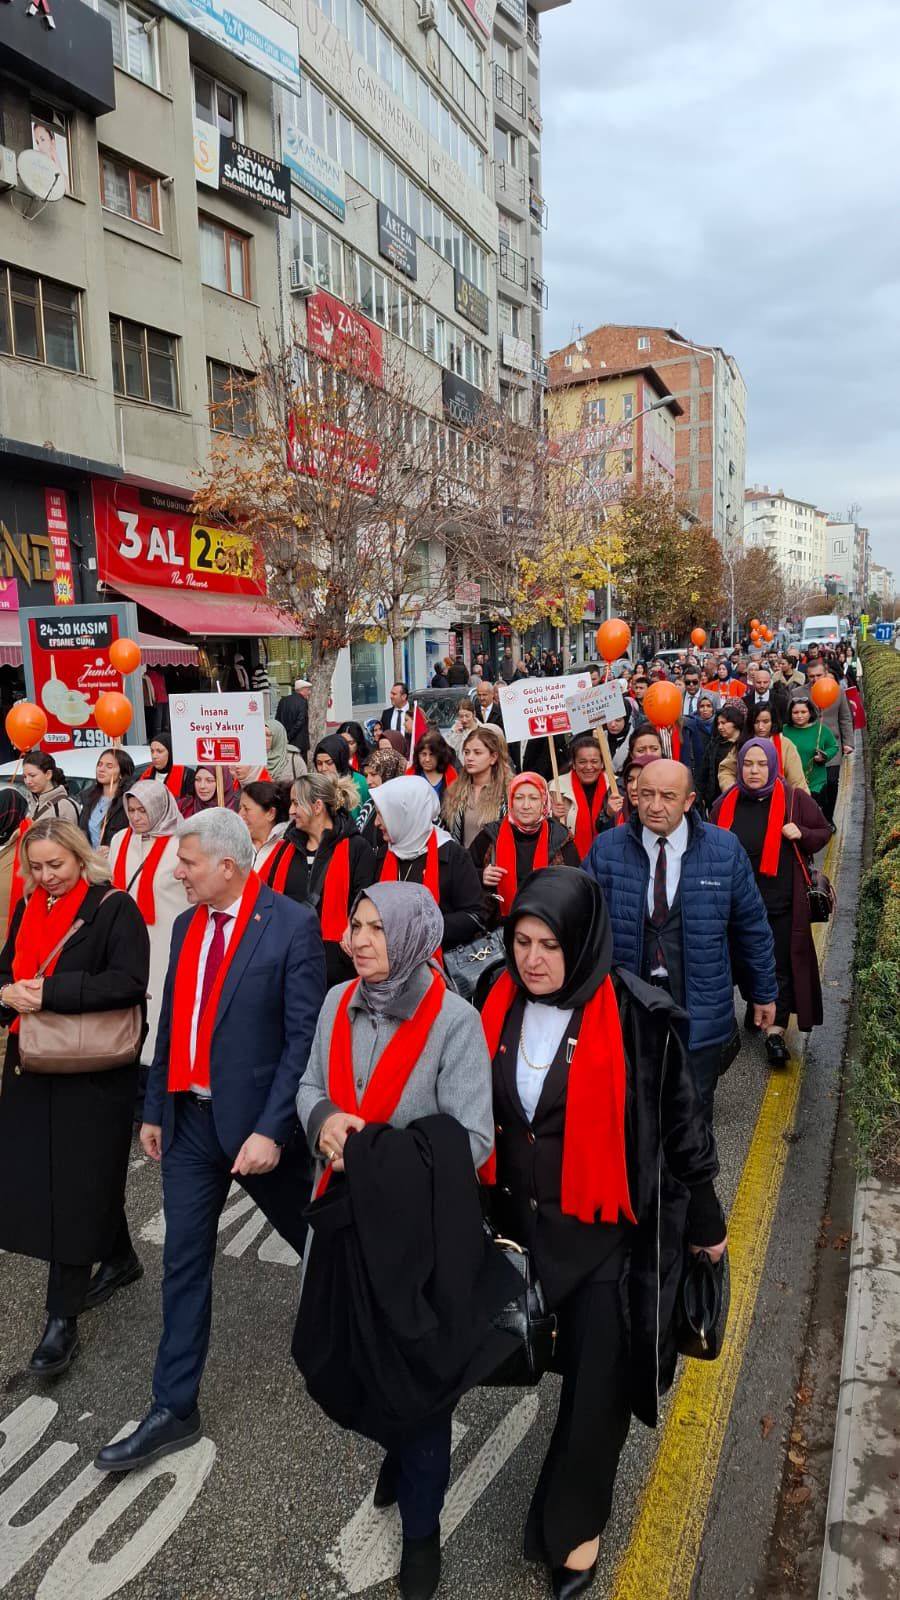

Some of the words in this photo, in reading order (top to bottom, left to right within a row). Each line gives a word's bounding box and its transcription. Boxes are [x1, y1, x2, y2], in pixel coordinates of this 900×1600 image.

[306, 2, 354, 73] UZAY
[298, 136, 340, 184] KARAMAN
[224, 164, 286, 204] SARIKABAK
[117, 510, 143, 559] 3
[147, 526, 185, 566] AL
[194, 529, 213, 569] 2
[0, 519, 56, 588] ND
[40, 623, 71, 636] 24-30
[73, 622, 108, 635] KASIM
[48, 638, 75, 647] EFSANE
[75, 637, 96, 647] CUMA
[77, 663, 117, 683] Jumbo
[523, 686, 543, 696] Güçlü
[545, 683, 566, 692] Kadın
[527, 695, 548, 705] Güçlü
[550, 693, 564, 701] Aile
[200, 704, 229, 717] İnsana
[523, 705, 544, 715] Güçlü
[546, 702, 567, 712] Toplu
[190, 722, 213, 734] Sevgi
[215, 721, 245, 733] Yakışır
